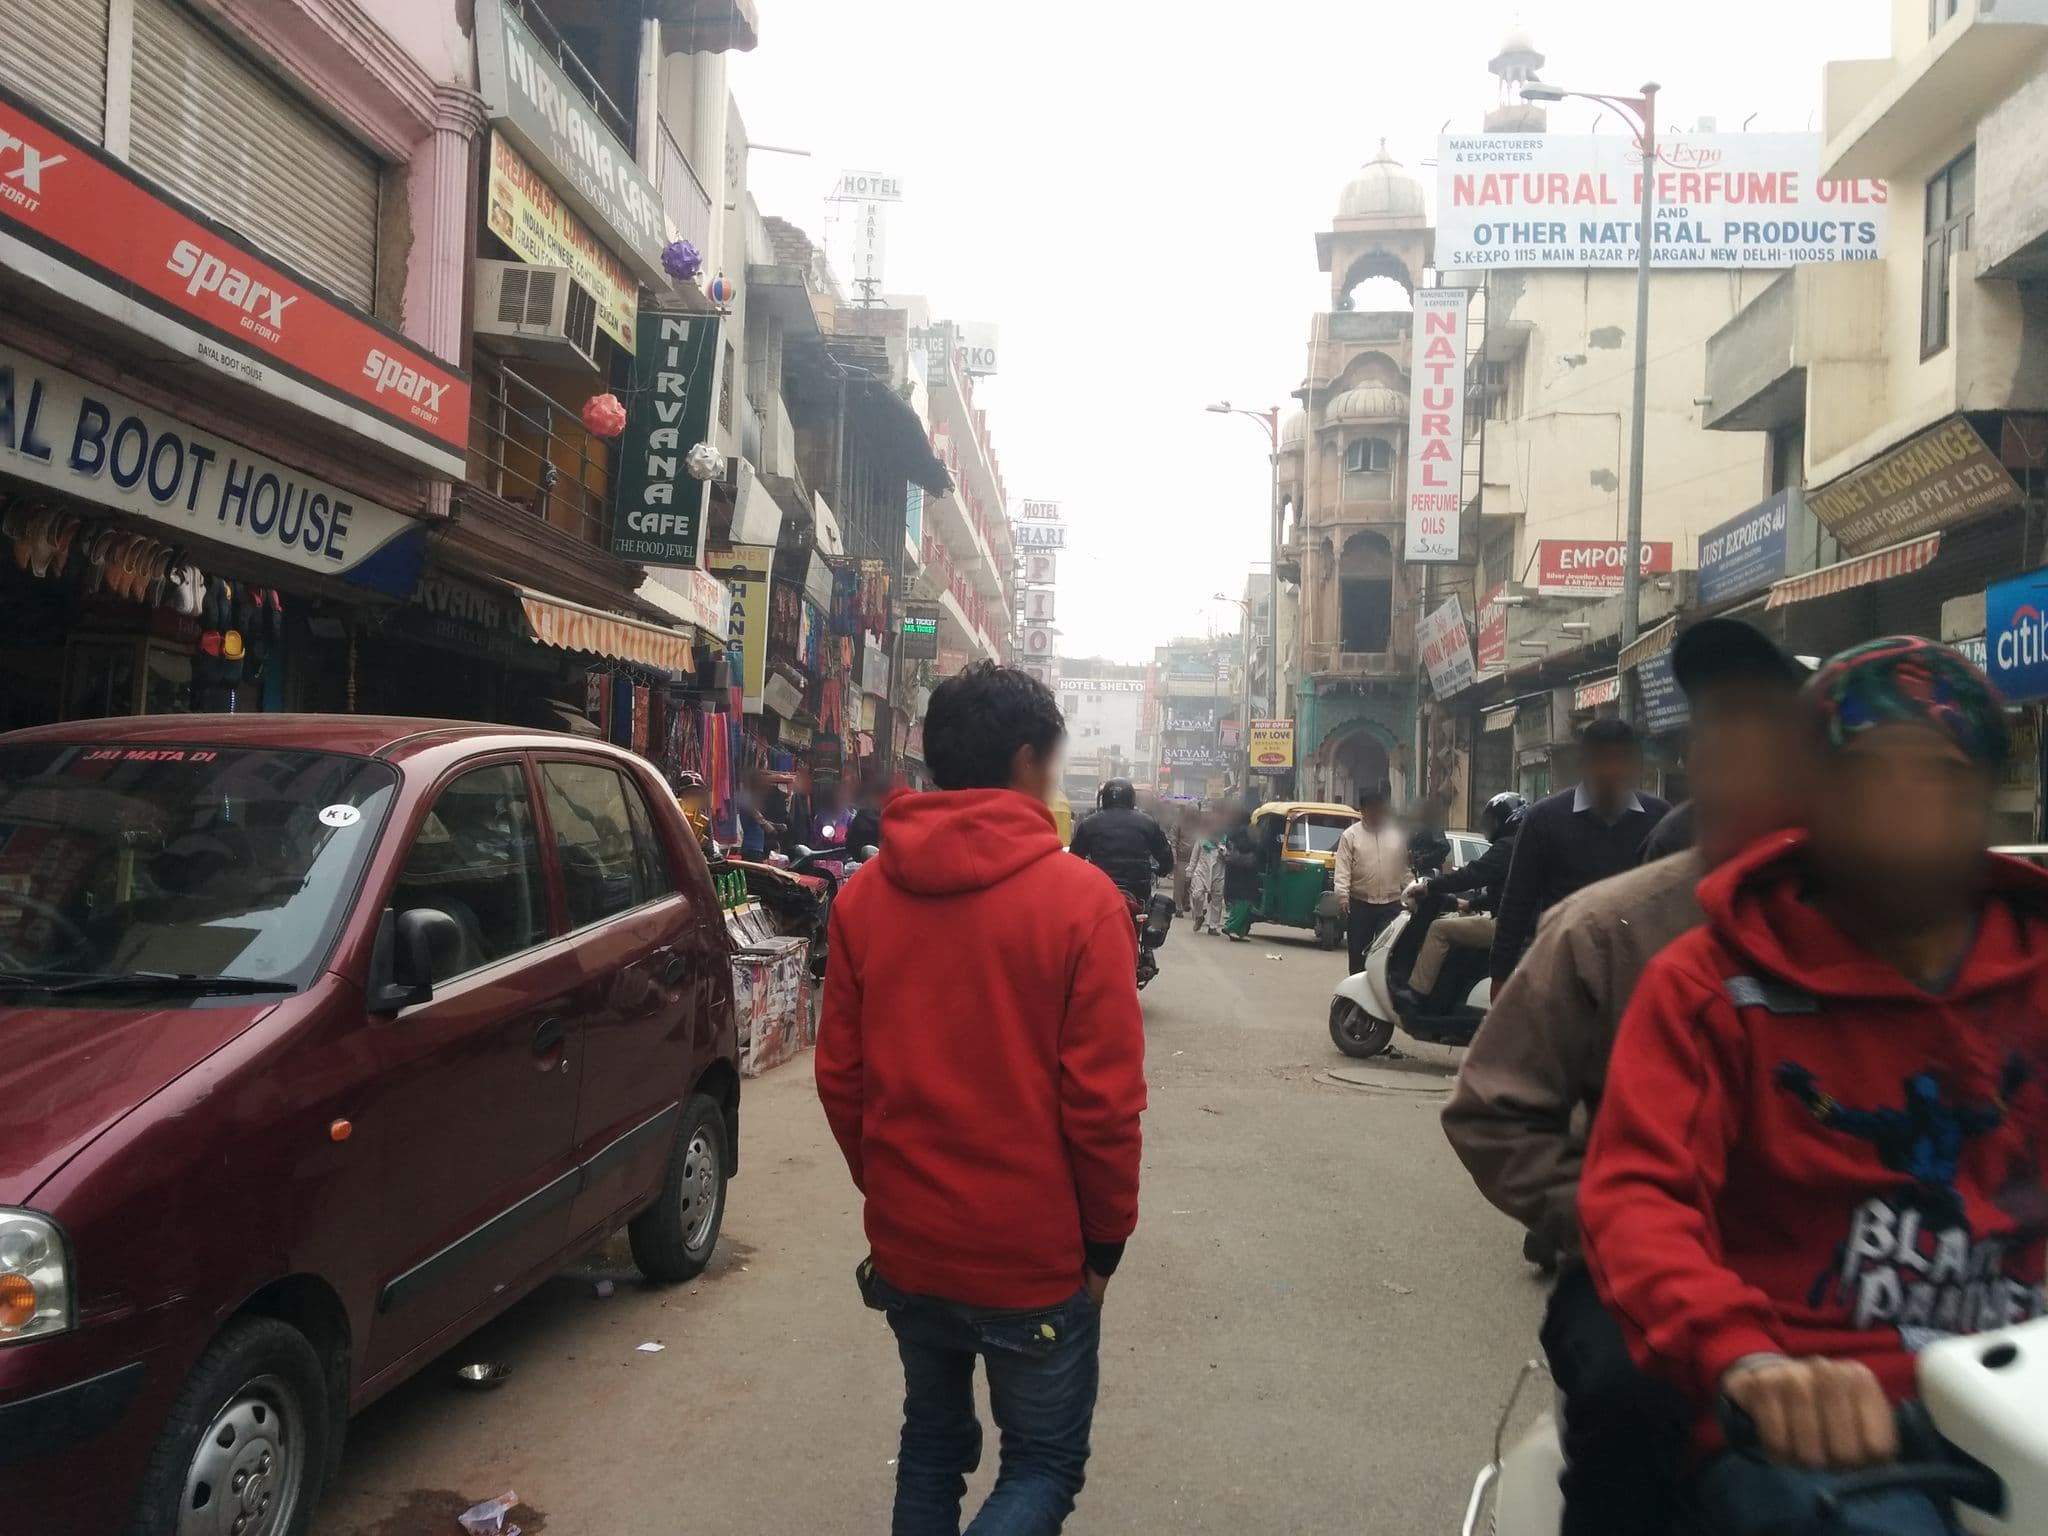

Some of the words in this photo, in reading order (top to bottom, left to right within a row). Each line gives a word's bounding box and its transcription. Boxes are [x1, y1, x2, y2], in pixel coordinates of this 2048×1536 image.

[507, 28, 615, 194] NIRVANA
[618, 166, 665, 246] CAFE
[1450, 140, 1543, 150] MANUFACTURERS
[1456, 153, 1464, 162] &
[1467, 152, 1533, 162] EXPORTERS
[579, 167, 609, 214] FOOD
[844, 176, 901, 195] HOTEL
[1453, 172, 1618, 207] NATURAL
[1633, 171, 1799, 206] PERFUME
[1816, 176, 1888, 205] OILS
[1657, 208, 1688, 219] AND
[1473, 221, 1567, 246] OTHER
[1724, 221, 1876, 244] PRODUCTS
[1515, 249, 1537, 261] 1115
[1542, 249, 1575, 261] MAIN
[1580, 249, 1623, 261] BAZAR
[1628, 249, 1705, 261] PAARGANJ
[1711, 249, 1737, 261] NEW
[1841, 249, 1879, 261] INDIA
[166, 240, 299, 329] sparx
[1420, 291, 1465, 299] MANUFACTURERS
[240, 316, 254, 330] GO
[253, 324, 271, 340] FOR
[198, 343, 219, 361] DAYAL
[220, 355, 239, 371] BOOT
[240, 363, 263, 381] HOUSE
[362, 349, 450, 413] sparx
[1420, 311, 1457, 487] NATURAL
[644, 318, 690, 505] NIRVANA
[69, 396, 216, 511] BOOT
[217, 457, 353, 561] HOUSE
[1815, 474, 1877, 526] MONEY
[1872, 422, 1984, 497] EXCHANGE
[1024, 502, 1058, 518] HOTEL
[1411, 494, 1458, 512] PERFUME
[1836, 515, 1876, 545] SINGH
[1874, 494, 1924, 532] FOREX
[1920, 479, 1959, 510] PVT.
[1955, 463, 2000, 491] LTD.
[627, 511, 690, 536] CAFE
[1018, 526, 1064, 545] HARI
[1421, 517, 1446, 534] OILS
[614, 538, 635, 552] THE
[636, 540, 664, 555] FOOD
[664, 543, 694, 560] JEWEL
[1700, 537, 1724, 569] JUST
[1725, 512, 1772, 557] EXPORTS
[1560, 544, 1652, 569] EMPOO
[1060, 680, 1096, 690] HOTEL
[1254, 731, 1267, 739] MY
[1270, 731, 1290, 739] LOVE
[83, 751, 117, 761] JAI
[124, 751, 184, 761] MATA
[190, 751, 218, 762] DI
[1165, 749, 1210, 759] SATYAM
